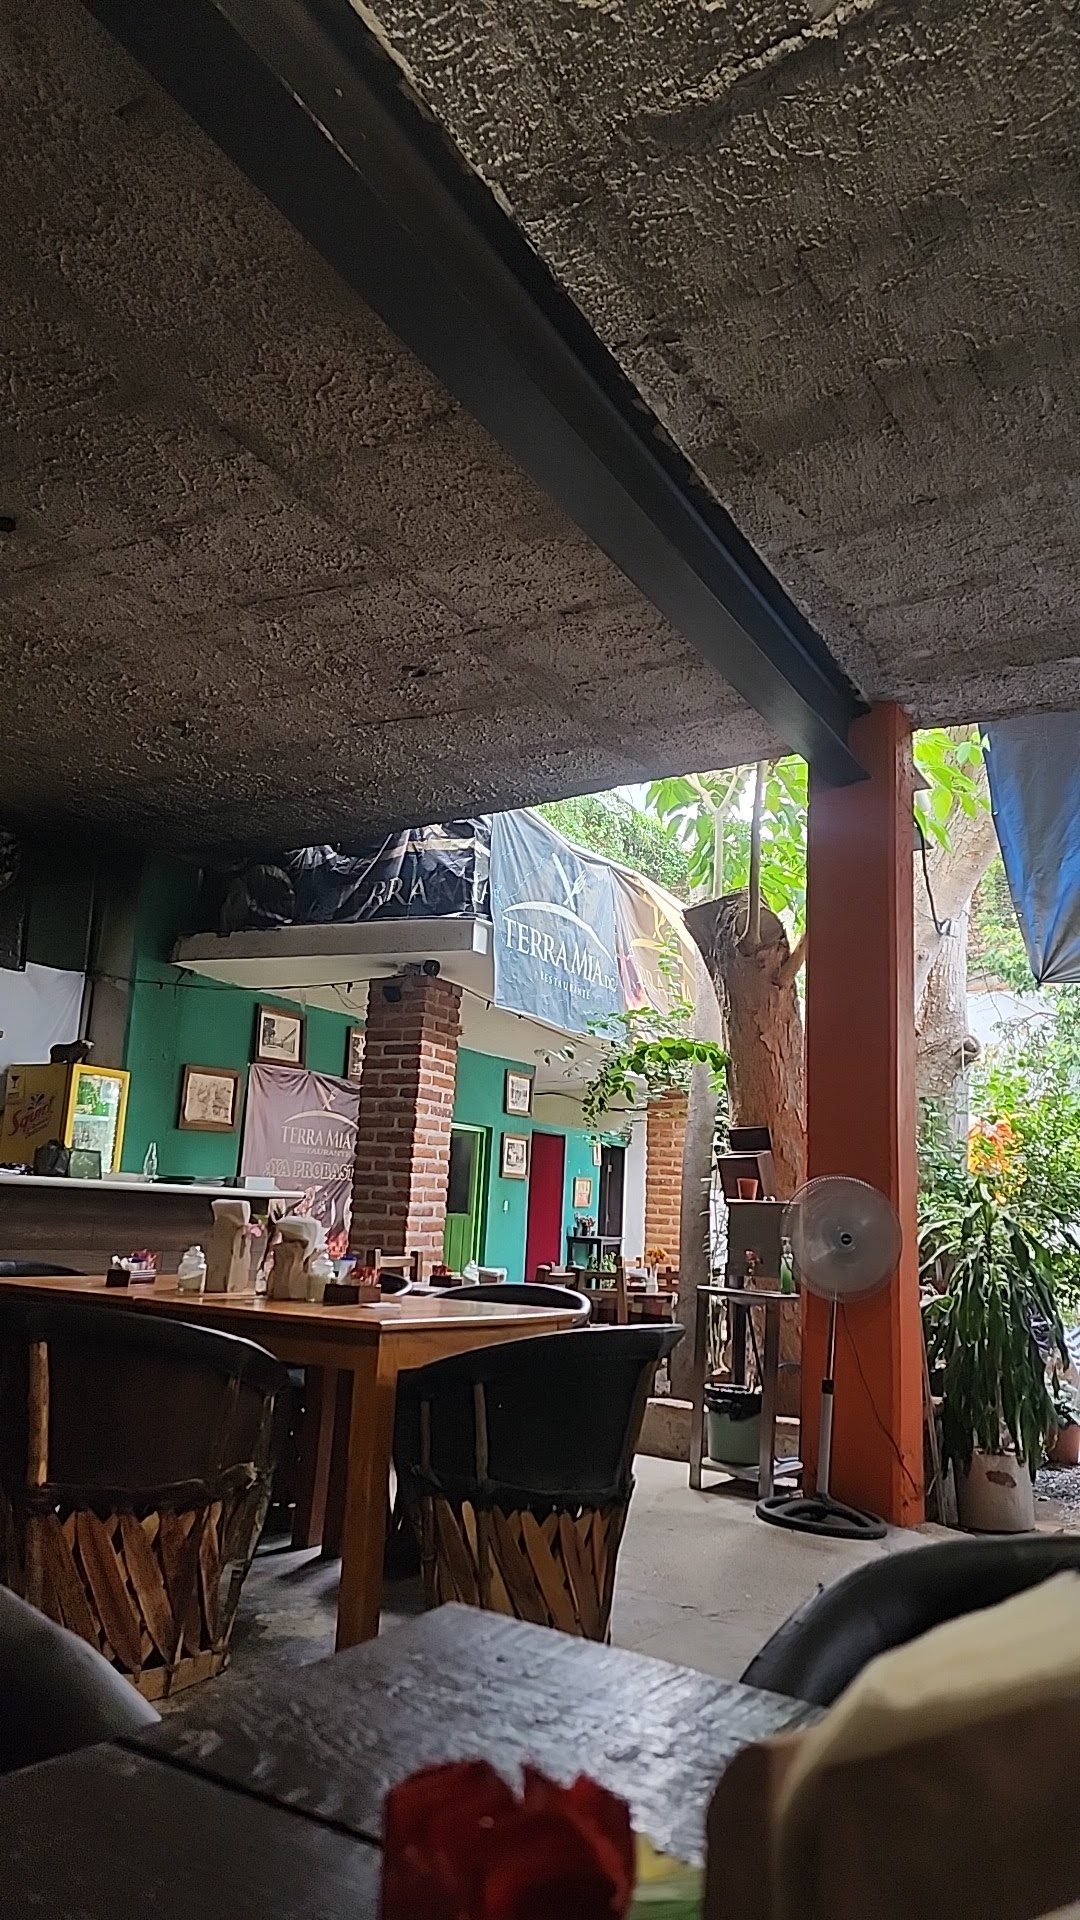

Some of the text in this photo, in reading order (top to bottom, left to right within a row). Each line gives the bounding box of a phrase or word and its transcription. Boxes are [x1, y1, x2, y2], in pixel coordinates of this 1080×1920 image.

[502, 915, 570, 973] TERRA
[571, 942, 604, 987] MIA
[281, 1125, 352, 1150] TERRA MIA
